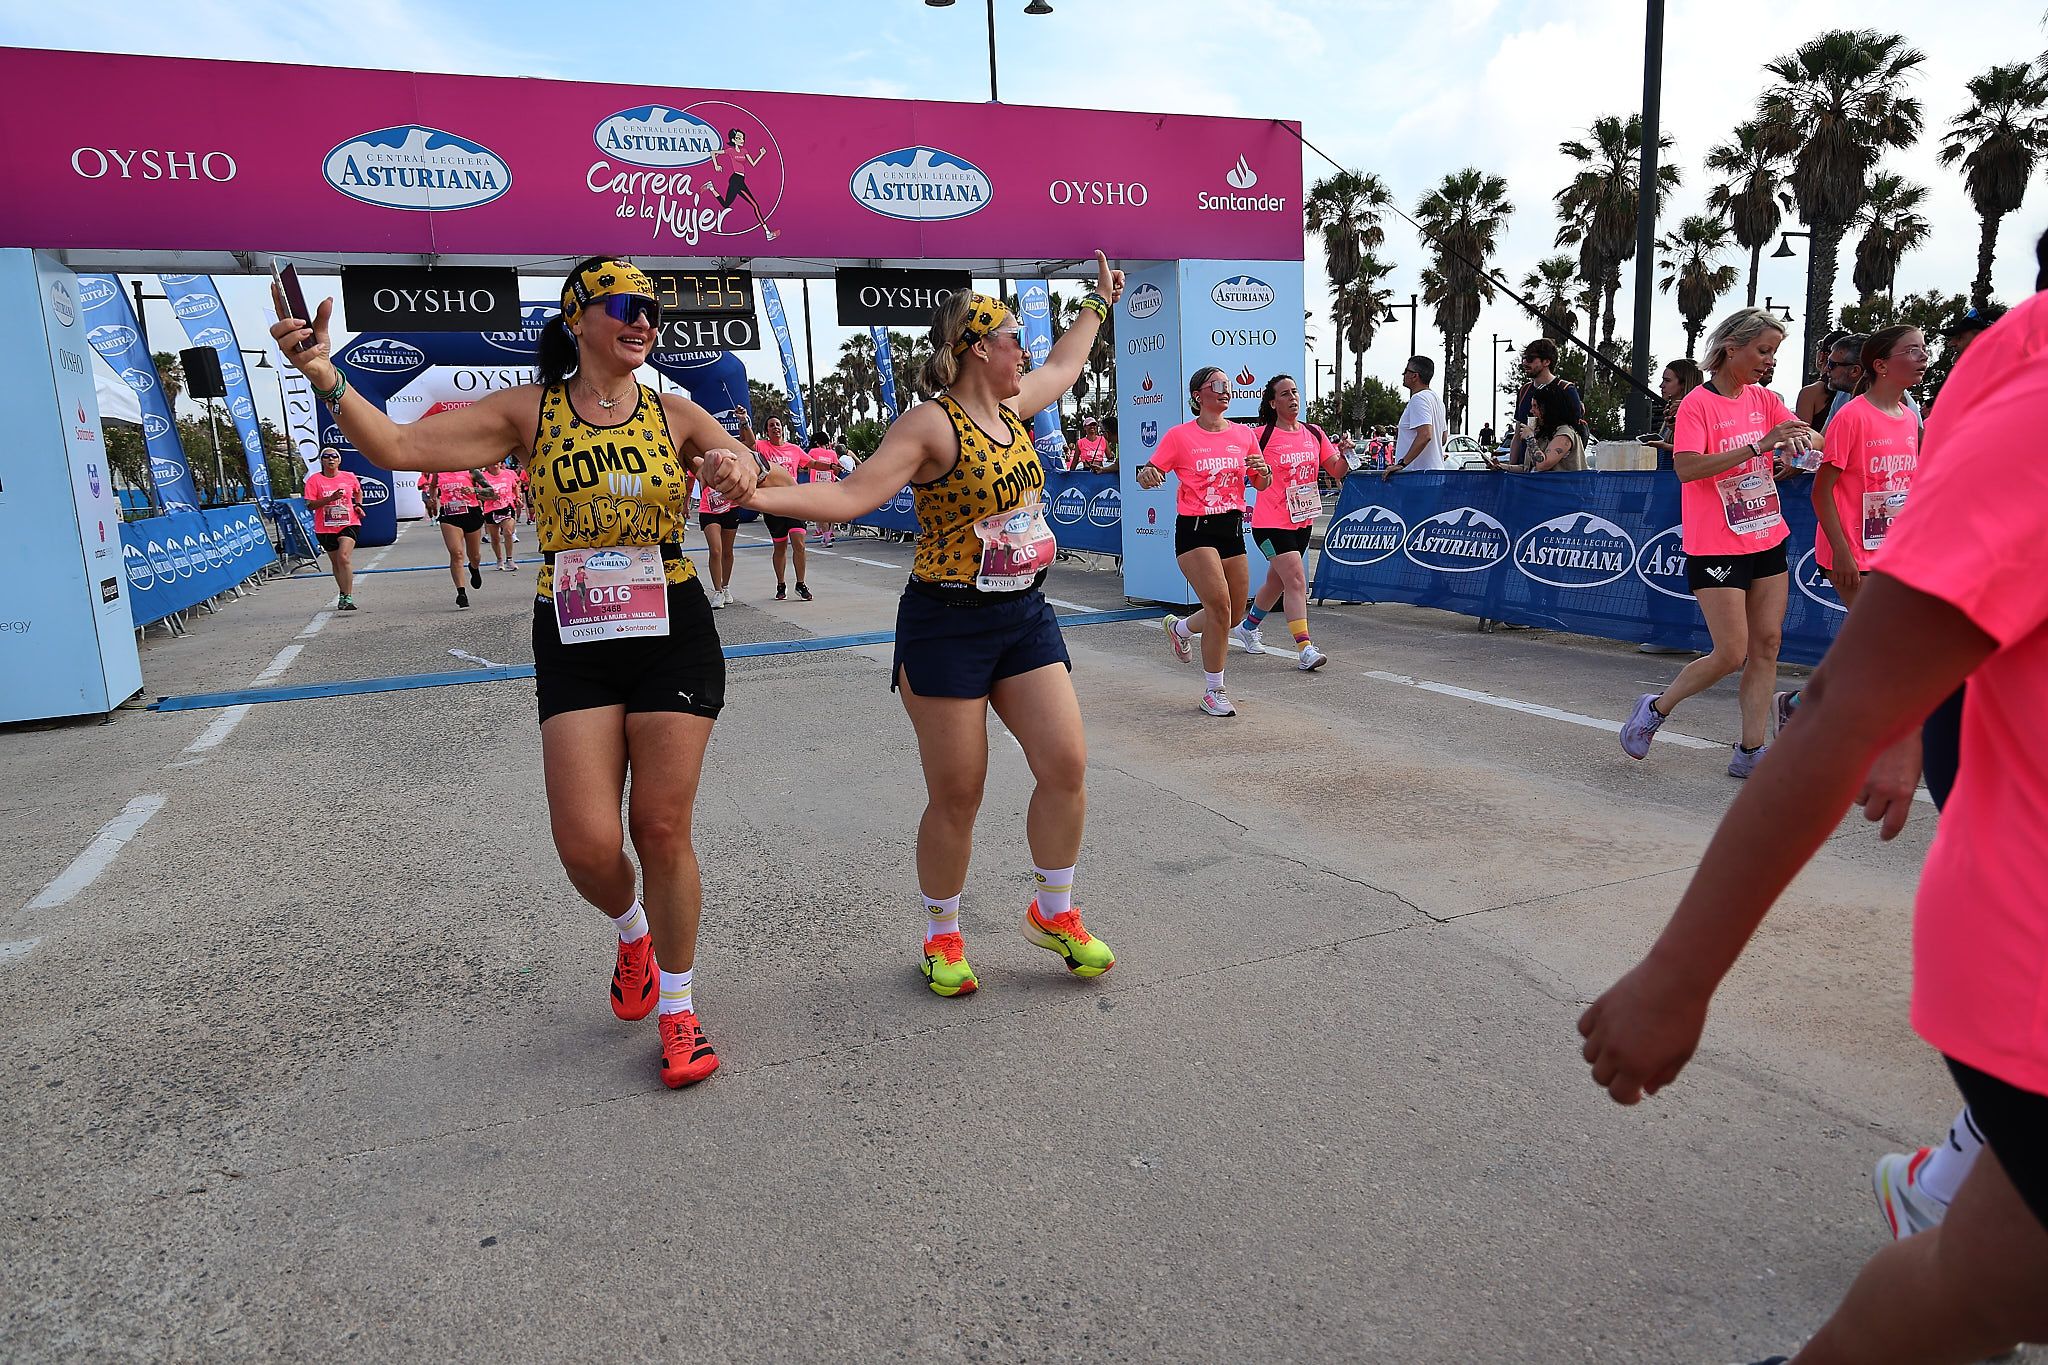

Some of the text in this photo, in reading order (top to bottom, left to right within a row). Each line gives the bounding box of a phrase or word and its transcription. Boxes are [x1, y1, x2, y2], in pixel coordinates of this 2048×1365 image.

[605, 126, 713, 153] ASTURIANA
[623, 125, 709, 135] CENTRAL LECHERA
[71, 147, 238, 182] OYSHO
[366, 153, 491, 166] CENTRAL LECHERA
[340, 154, 499, 190] ASTURIANA
[586, 161, 694, 197] Carrera
[883, 171, 977, 182] CENTRAL LECHERA
[862, 173, 982, 202] ASTURIANA
[1049, 180, 1148, 206] OYSHO
[1198, 192, 1286, 211] Santander
[616, 193, 733, 245] de la Mujer
[373, 289, 495, 313] OYSHO
[1216, 288, 1270, 302] ASTURIANA
[1128, 334, 1165, 355] OYSHO
[1211, 330, 1277, 346] OYSHO
[351, 350, 419, 365] ASTURIANA
[659, 350, 718, 362] ASTURIANA
[1133, 393, 1164, 406] Santander
[1196, 458, 1240, 472] CARRERA
[1280, 452, 1315, 464] CARRERA
[1869, 455, 1917, 474] CARRERA
[552, 442, 648, 494] COMO
[608, 473, 643, 497] UNA
[992, 460, 1042, 512] COMO
[1746, 497, 1766, 510] 016
[557, 495, 661, 542] CABRA
[1328, 526, 1397, 550] ASTURIANA
[1431, 528, 1463, 536] CENTRAL
[1755, 529, 1769, 539] 2026
[1408, 528, 1499, 559] ASTURIANA
[1543, 536, 1625, 549] CENTRAL LECHERA
[1519, 537, 1623, 572] ASTURIANA
[589, 585, 632, 604] 016
[569, 617, 593, 625] CARRERA
[608, 613, 628, 621] MUJER
[625, 624, 657, 632] Santander
[572, 626, 604, 637] OYSHO
